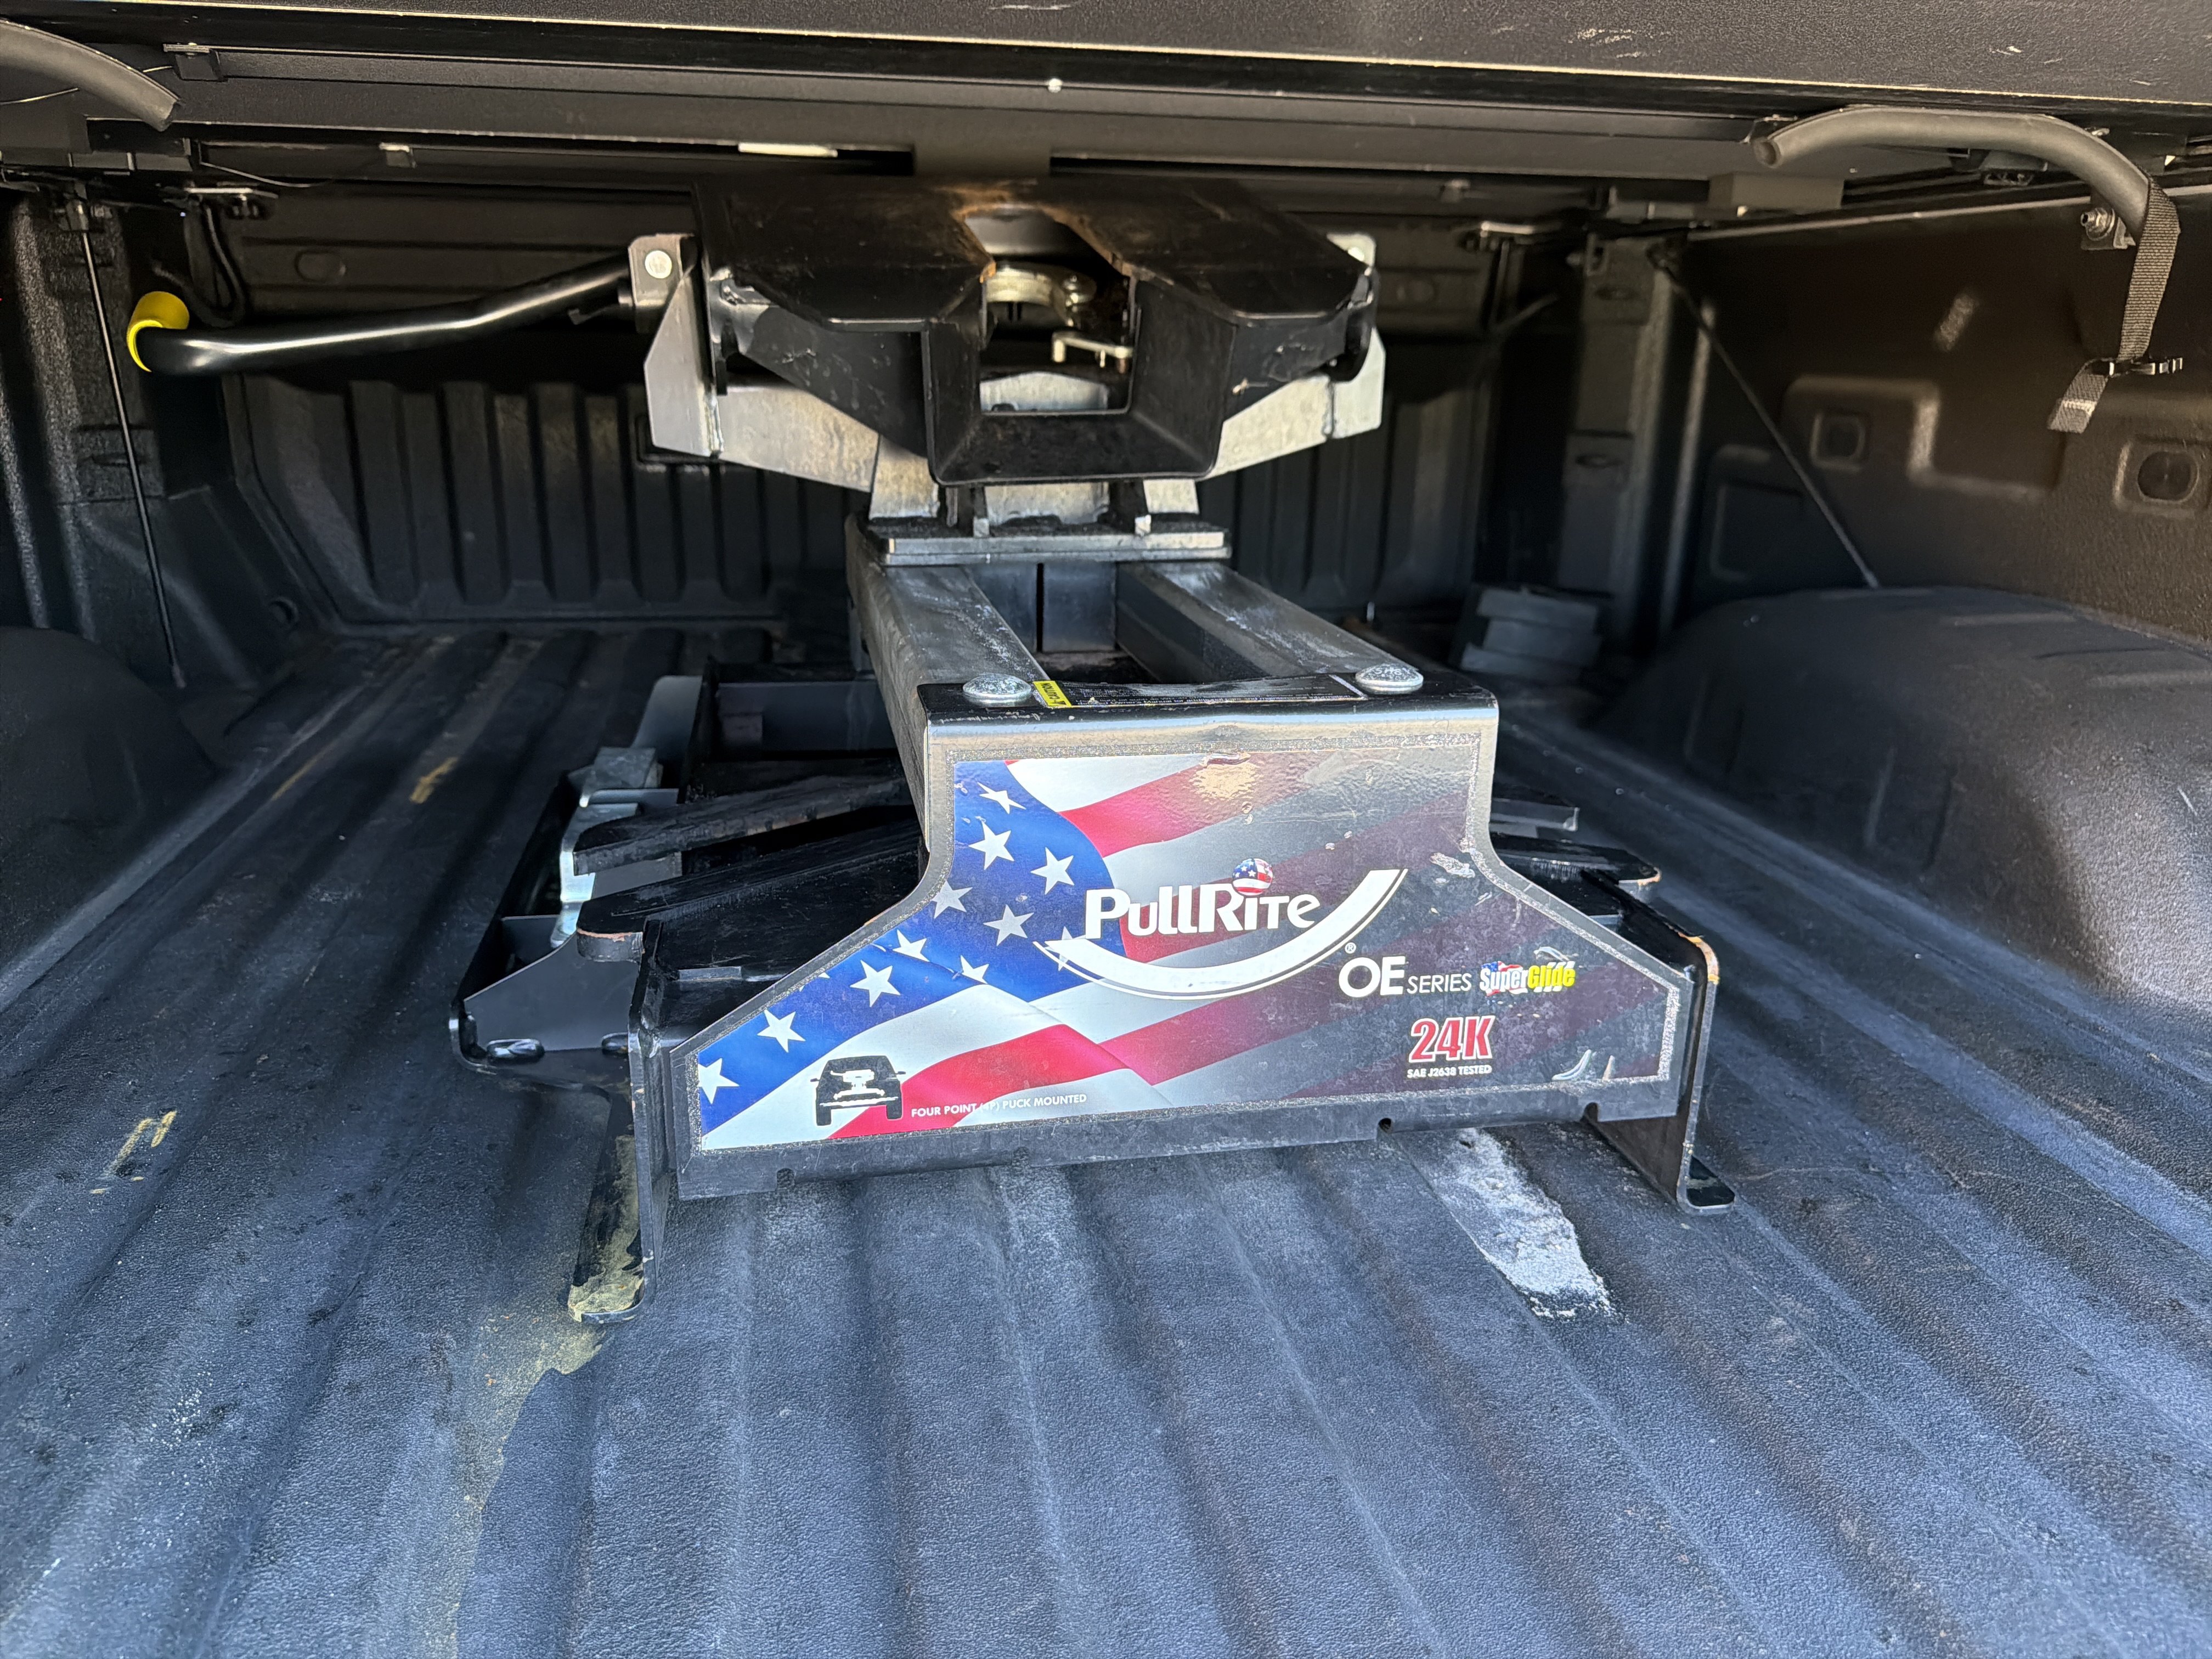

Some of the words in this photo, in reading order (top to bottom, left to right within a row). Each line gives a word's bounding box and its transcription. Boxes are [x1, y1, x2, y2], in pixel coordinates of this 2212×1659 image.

[1040, 682, 1061, 700] CAUTION
[1085, 883, 1320, 939] PullRite
[1338, 955, 1406, 998] OE
[1407, 973, 1472, 995] SERIES
[1480, 965, 1576, 991] SuperGlide
[1408, 1015, 1496, 1063] 24K
[1407, 1068, 1426, 1079] SAE
[1427, 1066, 1457, 1077] J2638
[1458, 1064, 1493, 1075] TESTED
[911, 1107, 941, 1118] FOUR
[944, 1103, 977, 1115] POINT
[1002, 1098, 1031, 1109] PUCK
[1034, 1094, 1087, 1107] MOUNTED
